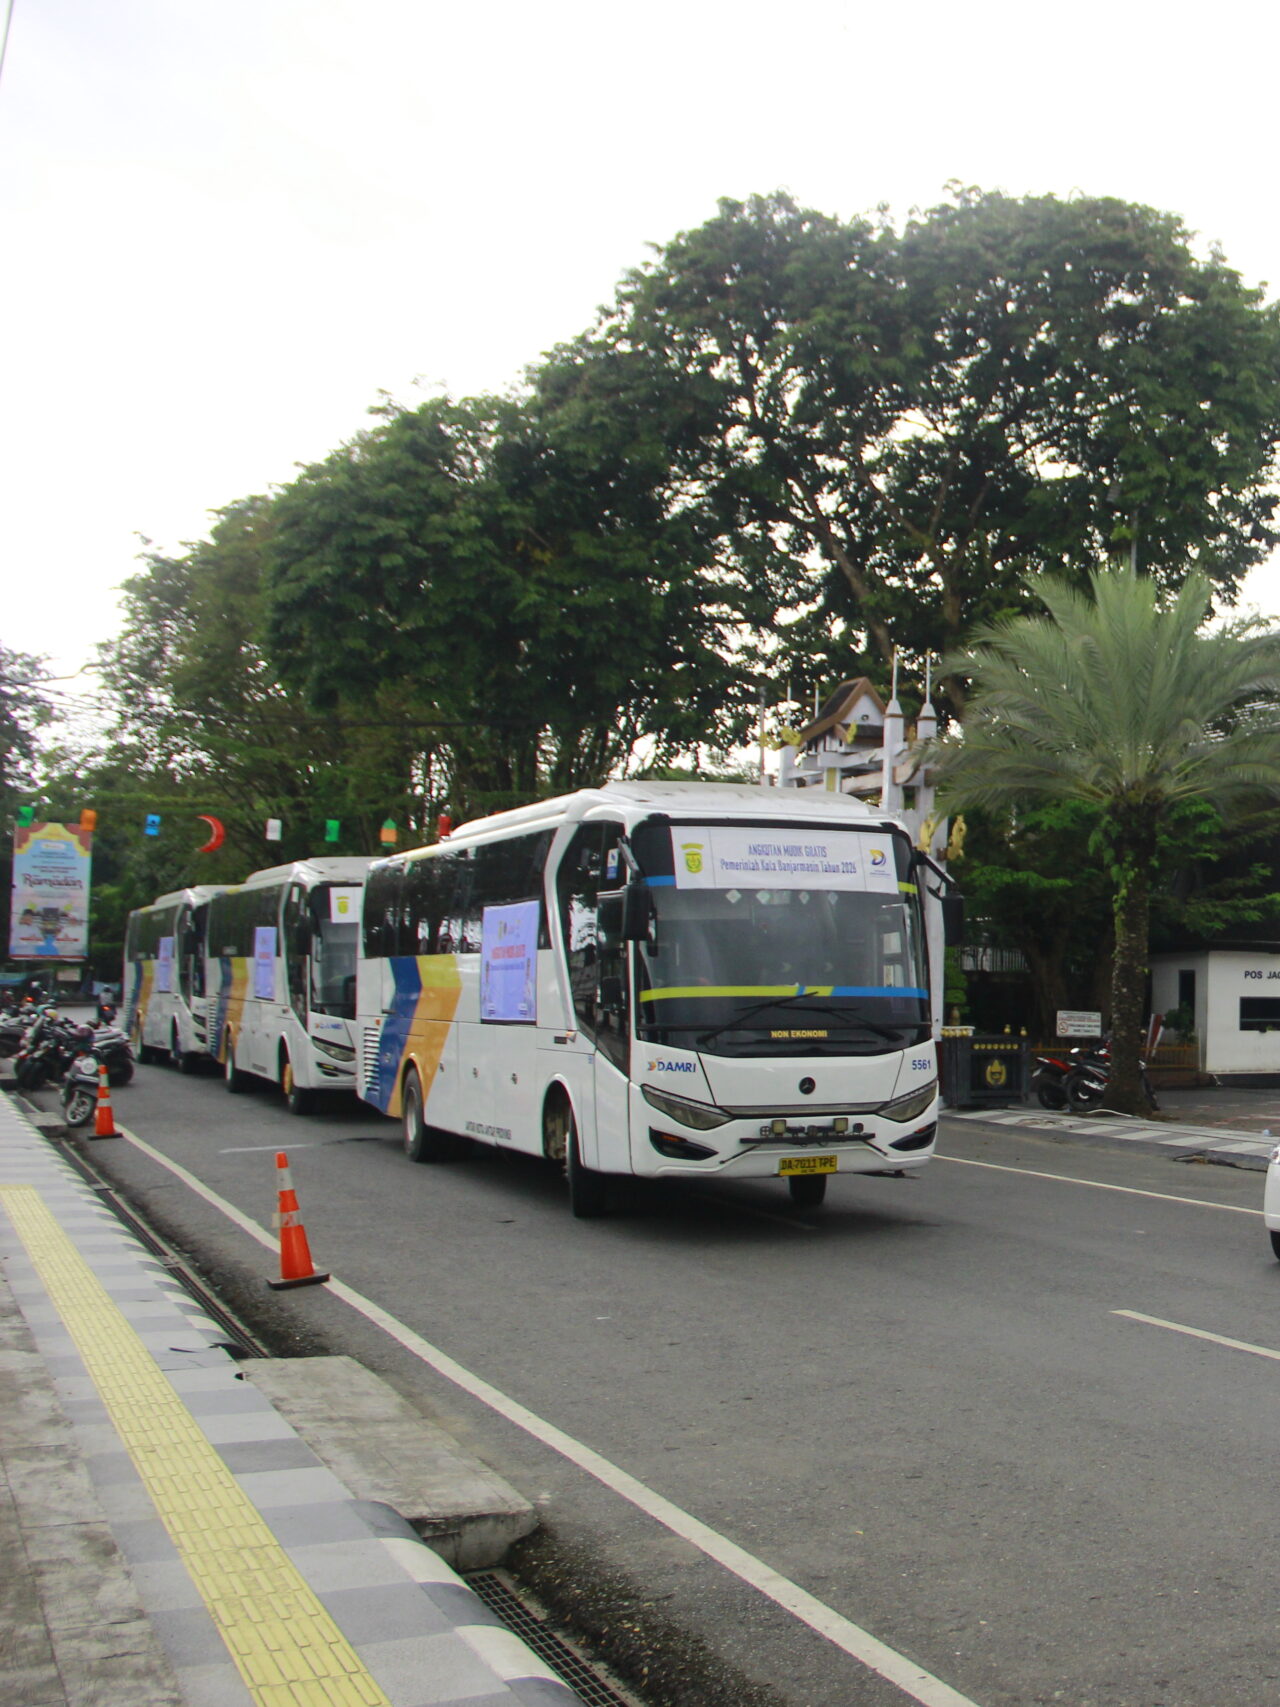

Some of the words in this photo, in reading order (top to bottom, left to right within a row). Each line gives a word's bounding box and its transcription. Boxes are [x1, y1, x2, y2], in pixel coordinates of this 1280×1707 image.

[749, 844, 782, 856] ANGKUTAN
[783, 845, 803, 857] MUDIK
[804, 846, 827, 858] GRATIS
[720, 858, 760, 871] Pemerintah
[761, 859, 777, 872] Kota
[778, 860, 819, 875] Banjarmasin
[820, 861, 840, 873] Tahun
[1244, 971, 1263, 980] POS
[771, 1030, 788, 1038] NON
[791, 1030, 828, 1039] EKONOMI
[657, 1060, 697, 1073] DAMRI
[911, 1059, 932, 1071] 5561
[781, 1158, 793, 1170] DA
